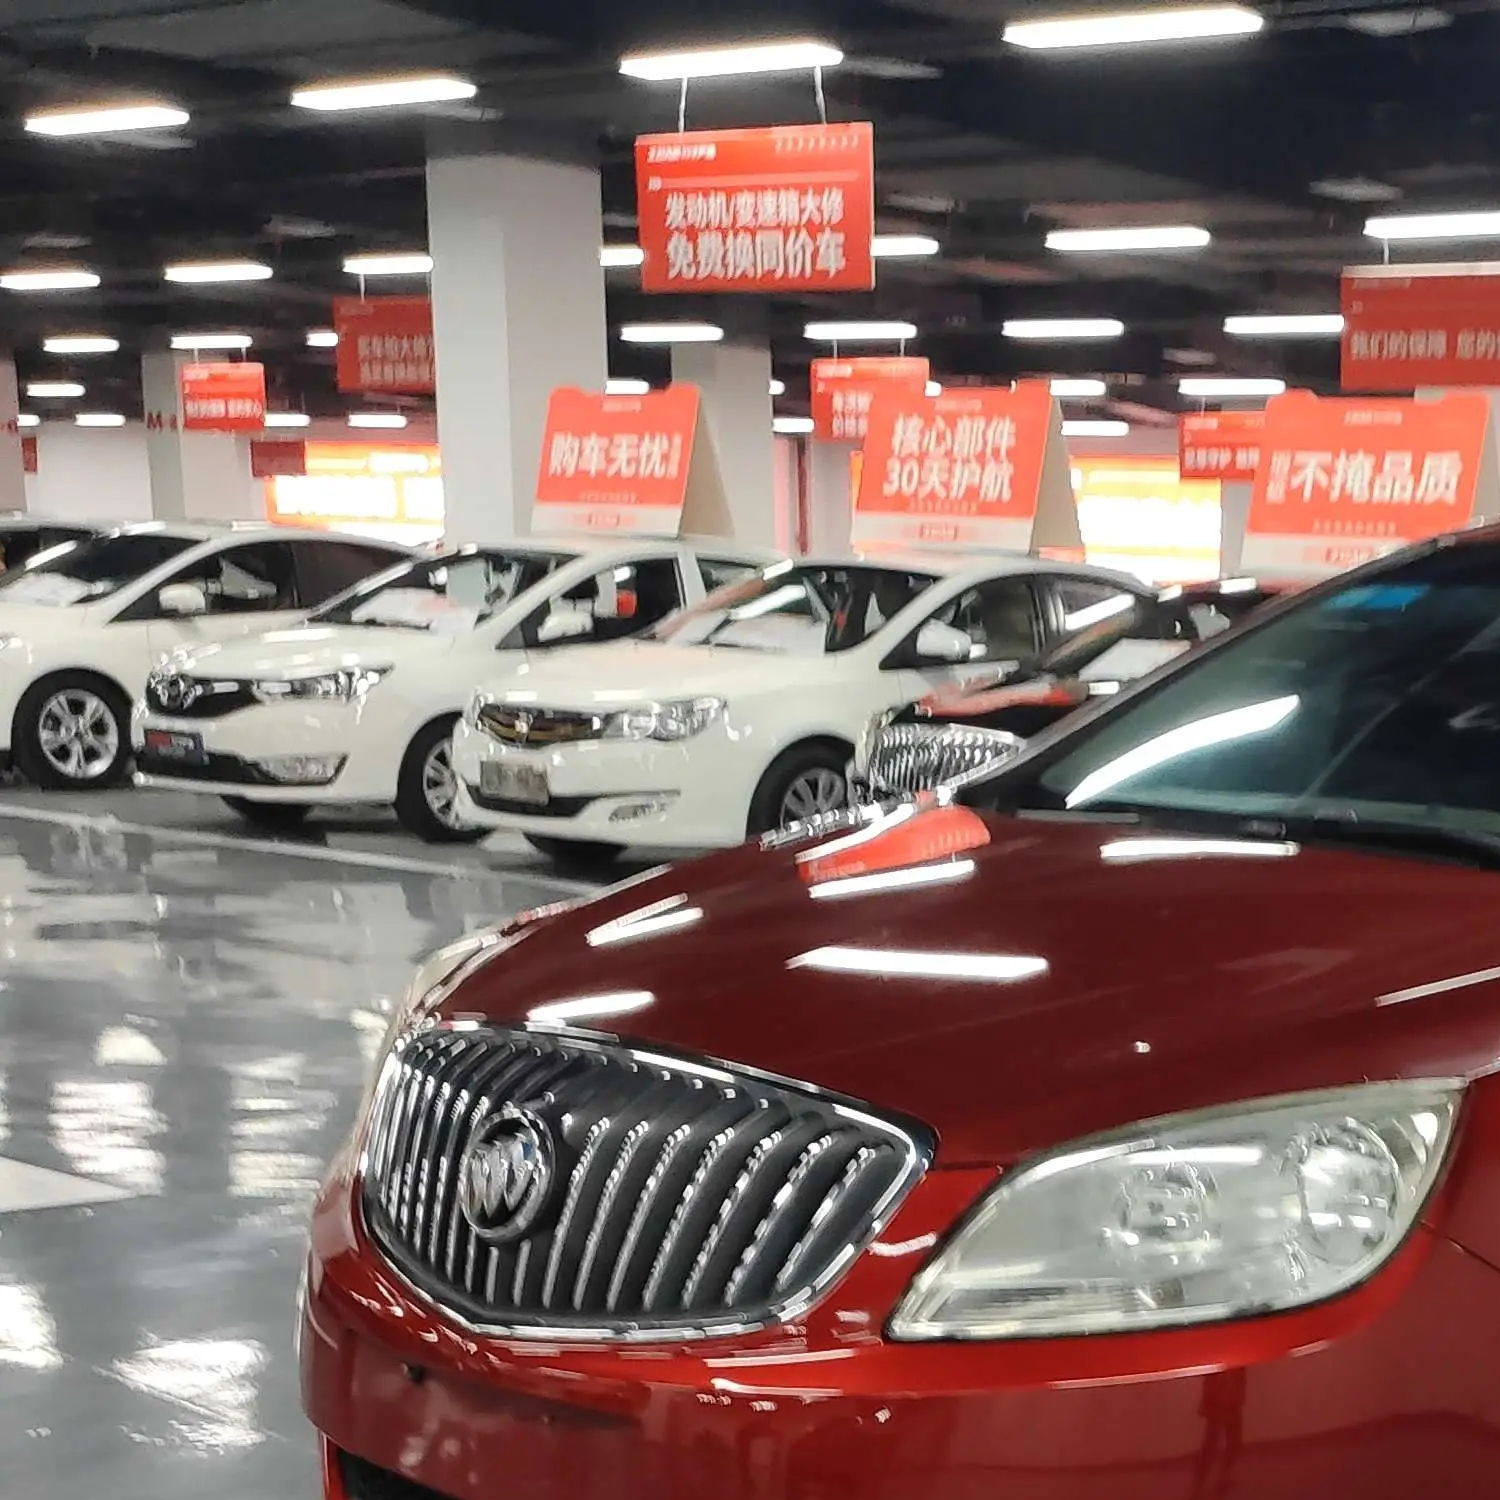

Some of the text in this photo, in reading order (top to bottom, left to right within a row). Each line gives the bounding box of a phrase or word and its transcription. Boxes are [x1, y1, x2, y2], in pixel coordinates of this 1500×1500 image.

[666, 227, 846, 280] 免费换同价车
[549, 432, 669, 478] 购车无忧
[891, 413, 1016, 458] 核心部件
[883, 457, 1014, 503] 30天护航
[1290, 448, 1462, 505] 不掩品质
